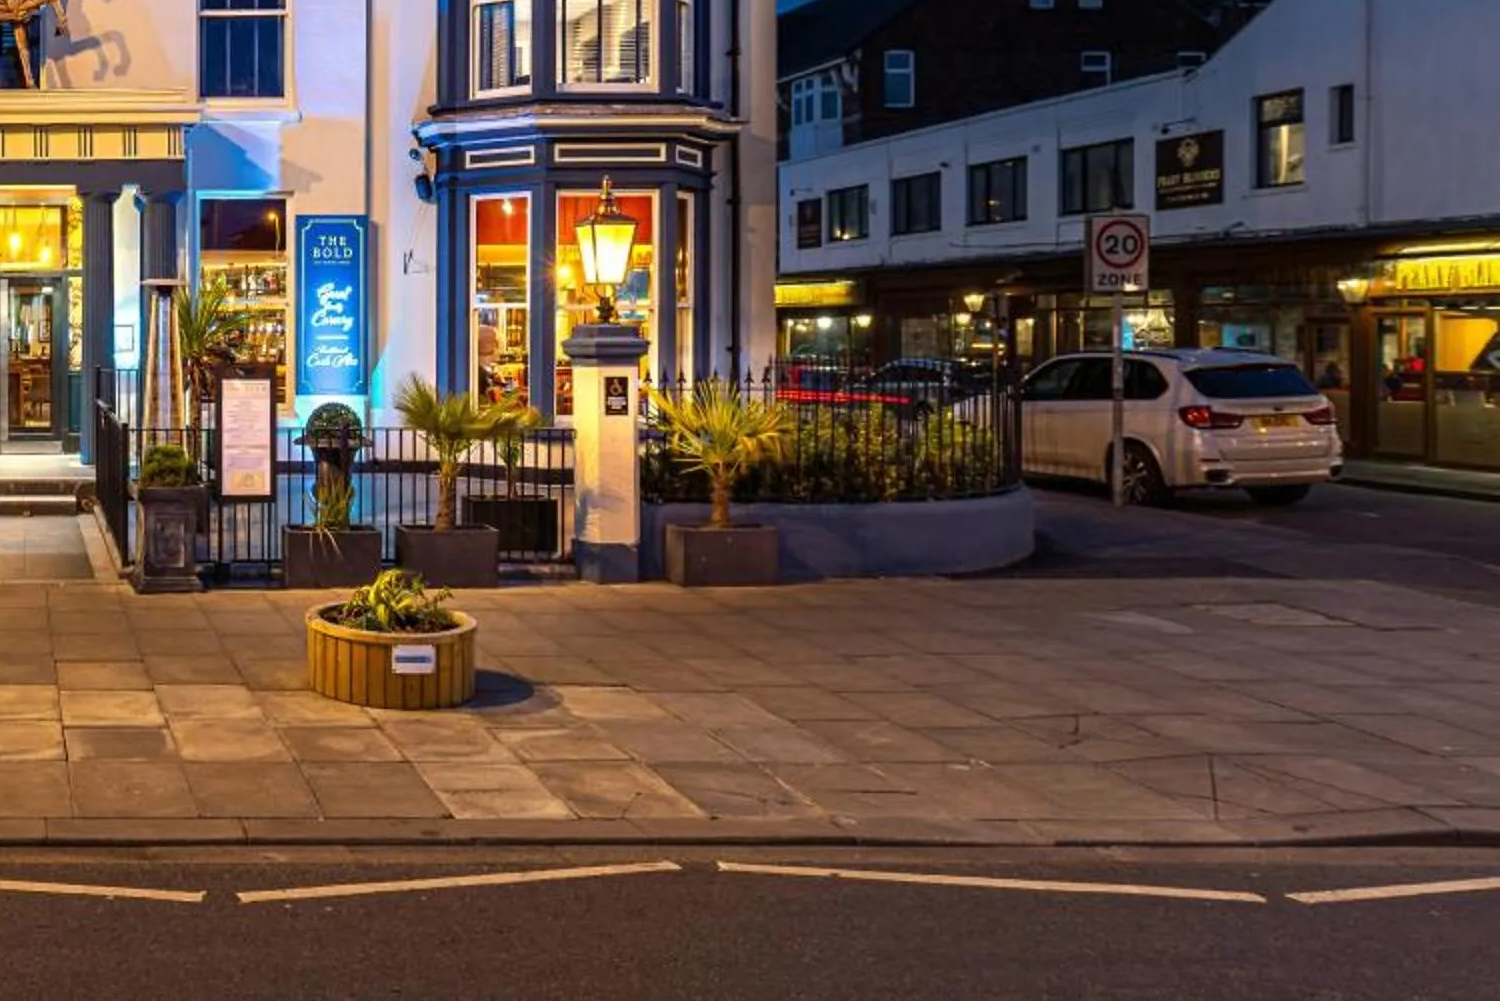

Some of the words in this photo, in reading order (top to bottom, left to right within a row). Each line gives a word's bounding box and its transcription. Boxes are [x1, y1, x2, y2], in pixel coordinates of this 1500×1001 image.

[319, 235, 347, 246] THE
[1104, 235, 1139, 255] 20
[313, 246, 353, 258] BOLD
[1098, 273, 1142, 286] ZONE
